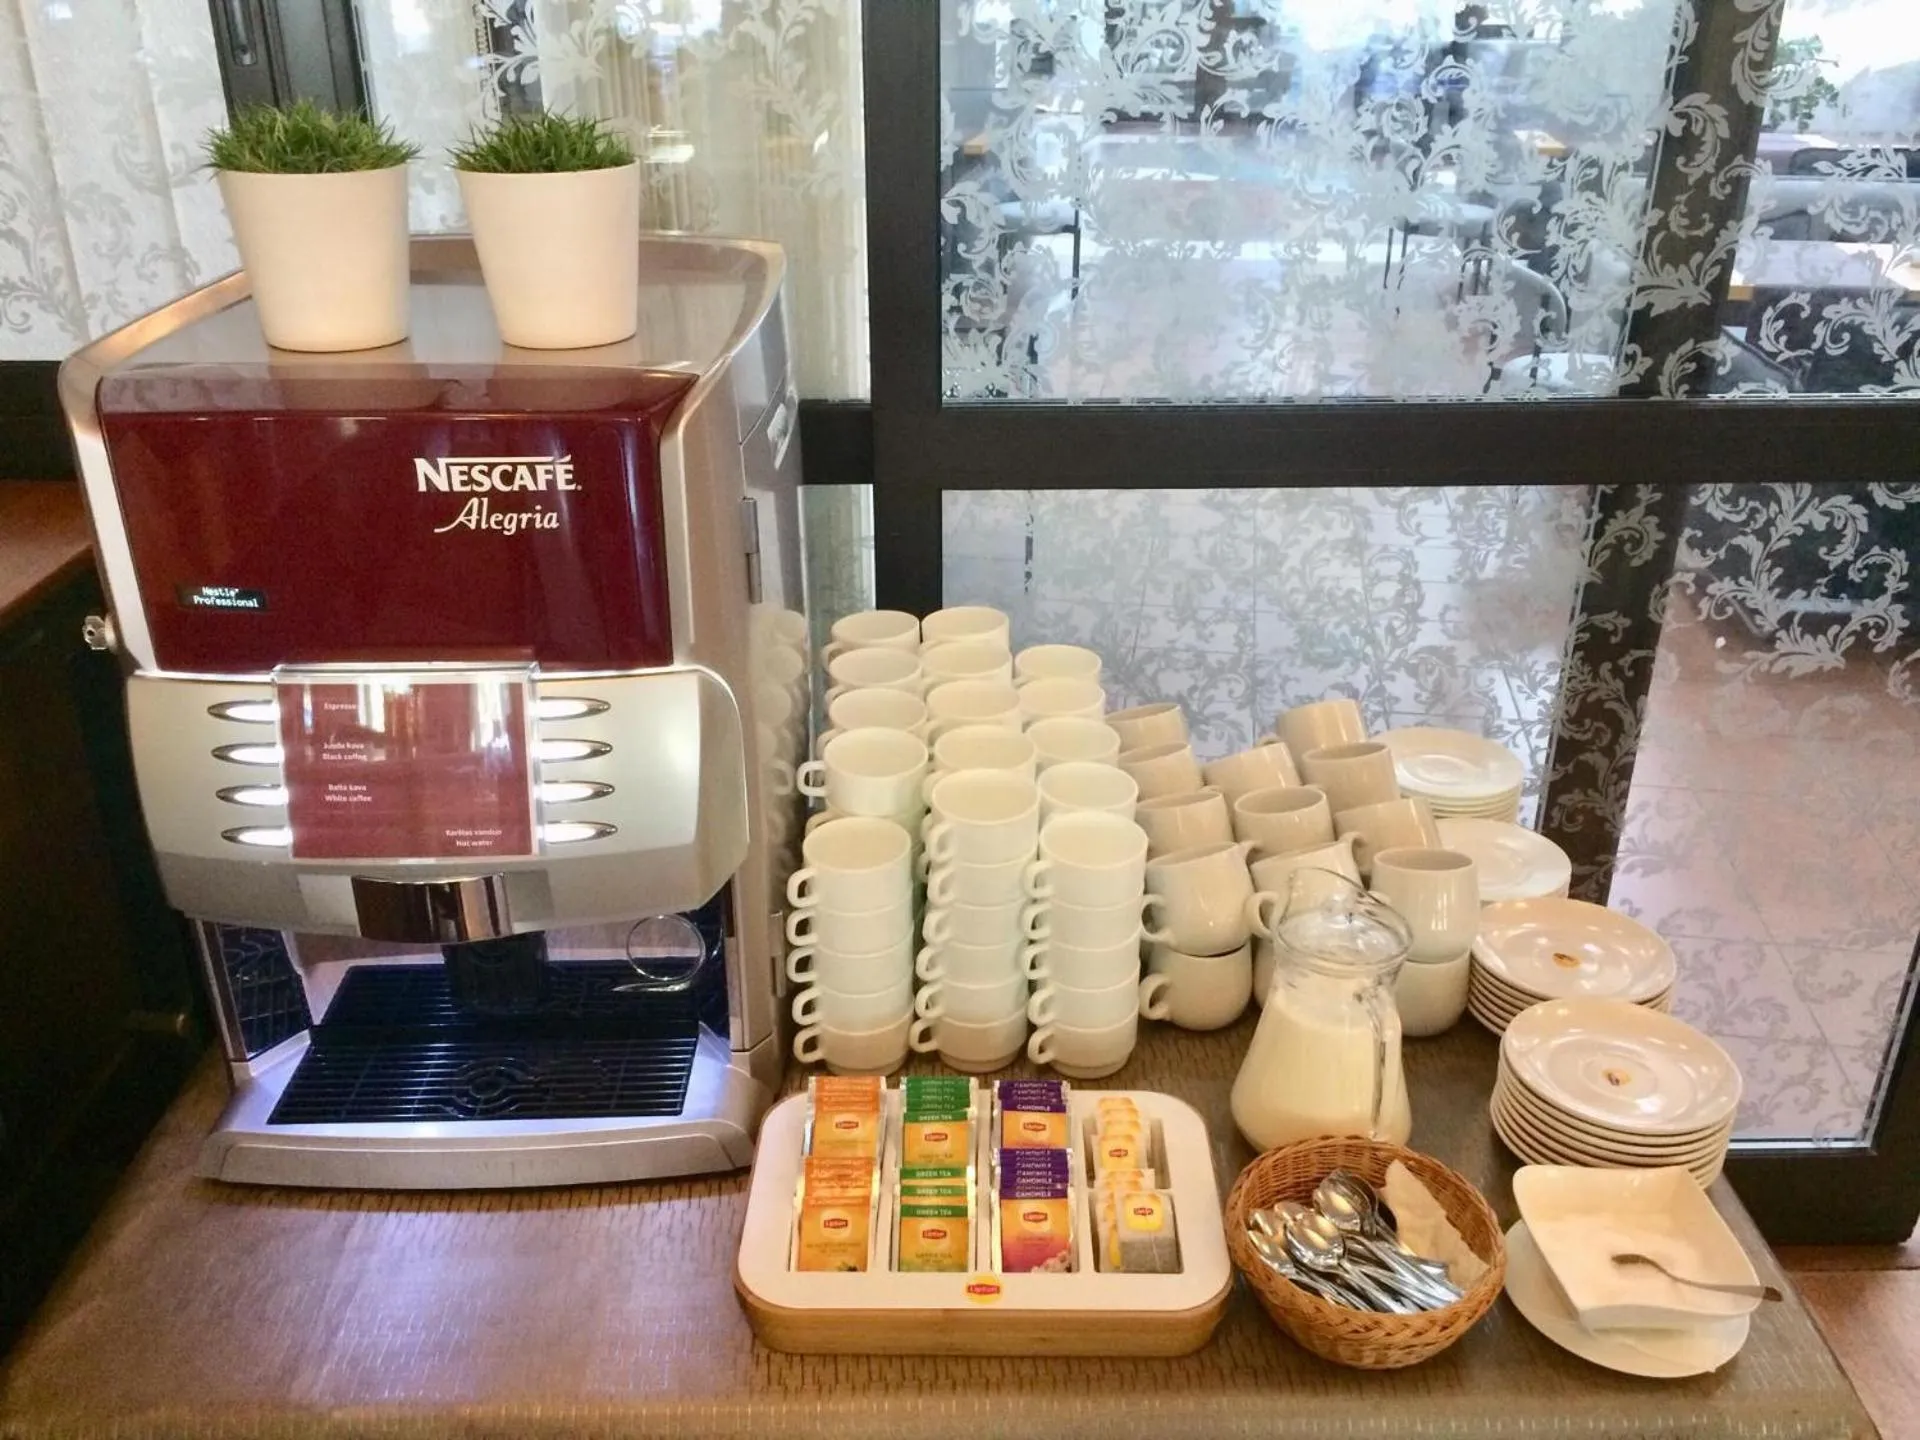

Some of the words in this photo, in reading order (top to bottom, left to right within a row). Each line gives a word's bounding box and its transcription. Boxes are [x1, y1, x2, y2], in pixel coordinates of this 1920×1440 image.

[414, 454, 577, 492] NESCAFÉ
[434, 497, 560, 536] Alegria
[193, 595, 259, 608] Professional
[323, 702, 357, 711] Espresso
[346, 741, 365, 749] kava
[322, 753, 342, 761] Black
[343, 753, 368, 761] coffee
[348, 783, 367, 791] kava
[325, 794, 347, 802] White
[348, 794, 372, 802] coffee
[1016, 1104, 1051, 1112] CAMOMILE
[824, 1218, 848, 1229] Lipton
[922, 1229, 947, 1240] Lipton
[968, 1284, 1000, 1295] Lipton
